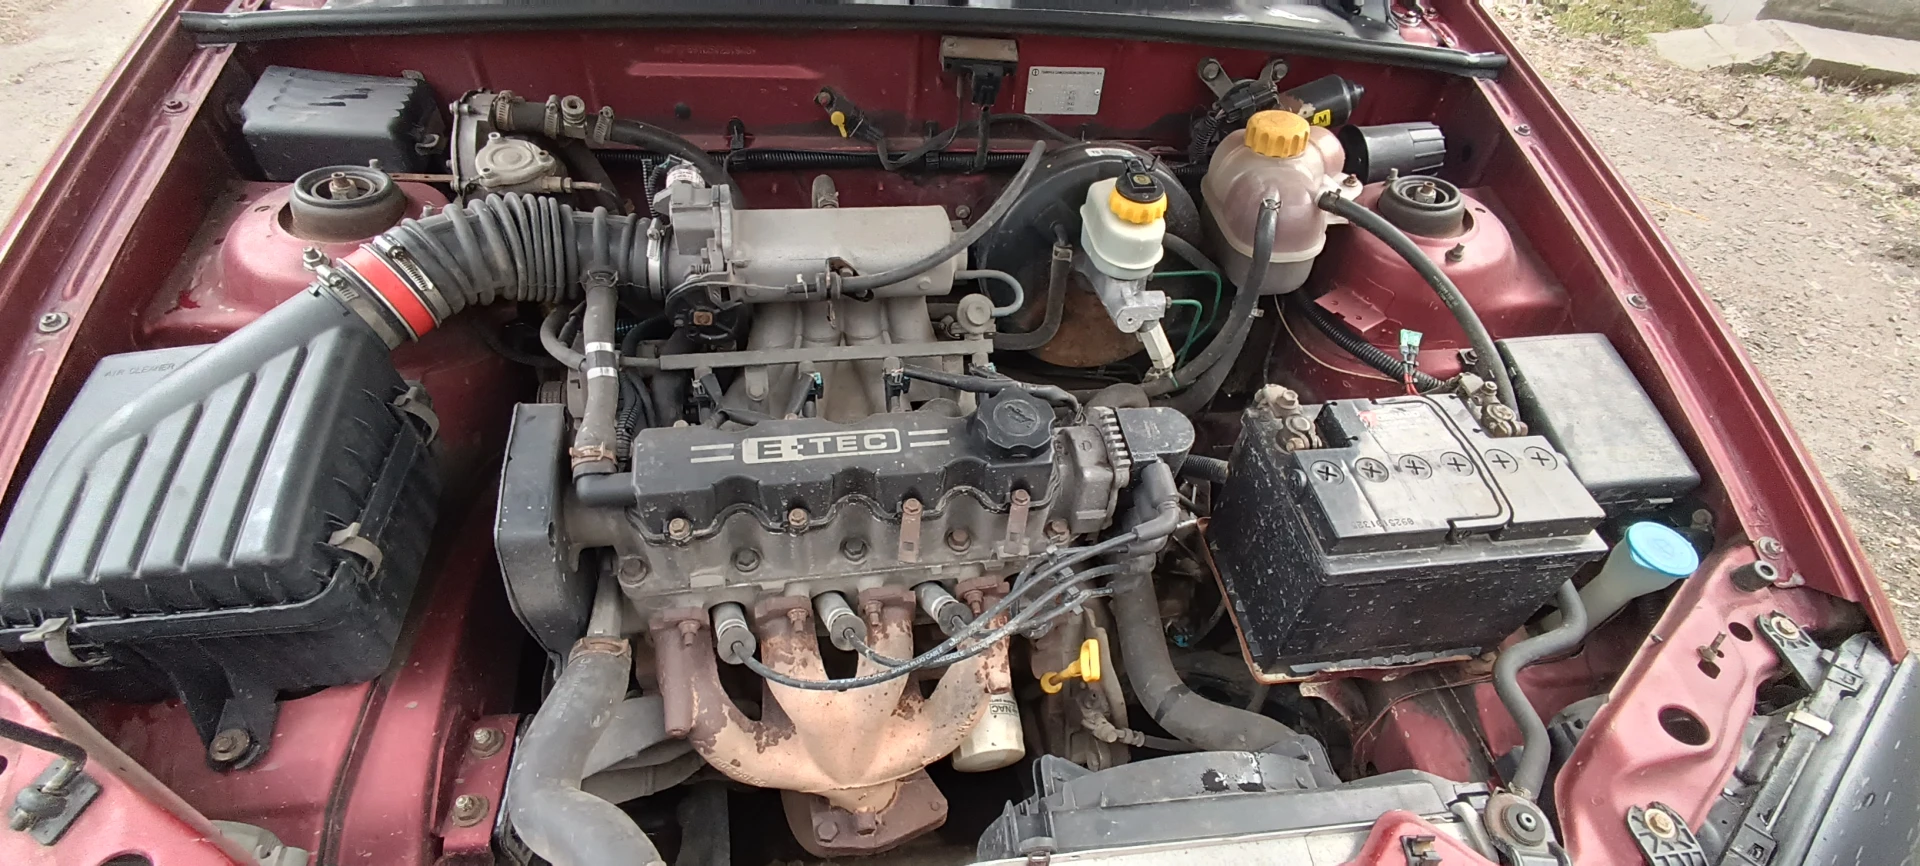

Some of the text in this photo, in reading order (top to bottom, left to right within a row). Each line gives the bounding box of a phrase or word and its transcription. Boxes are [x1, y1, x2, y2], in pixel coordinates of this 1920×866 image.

[104, 363, 176, 377] AIR CLEANER
[891, 663, 911, 674] SPARK
[910, 656, 926, 667] PLUG
[925, 646, 943, 660] CABLE
